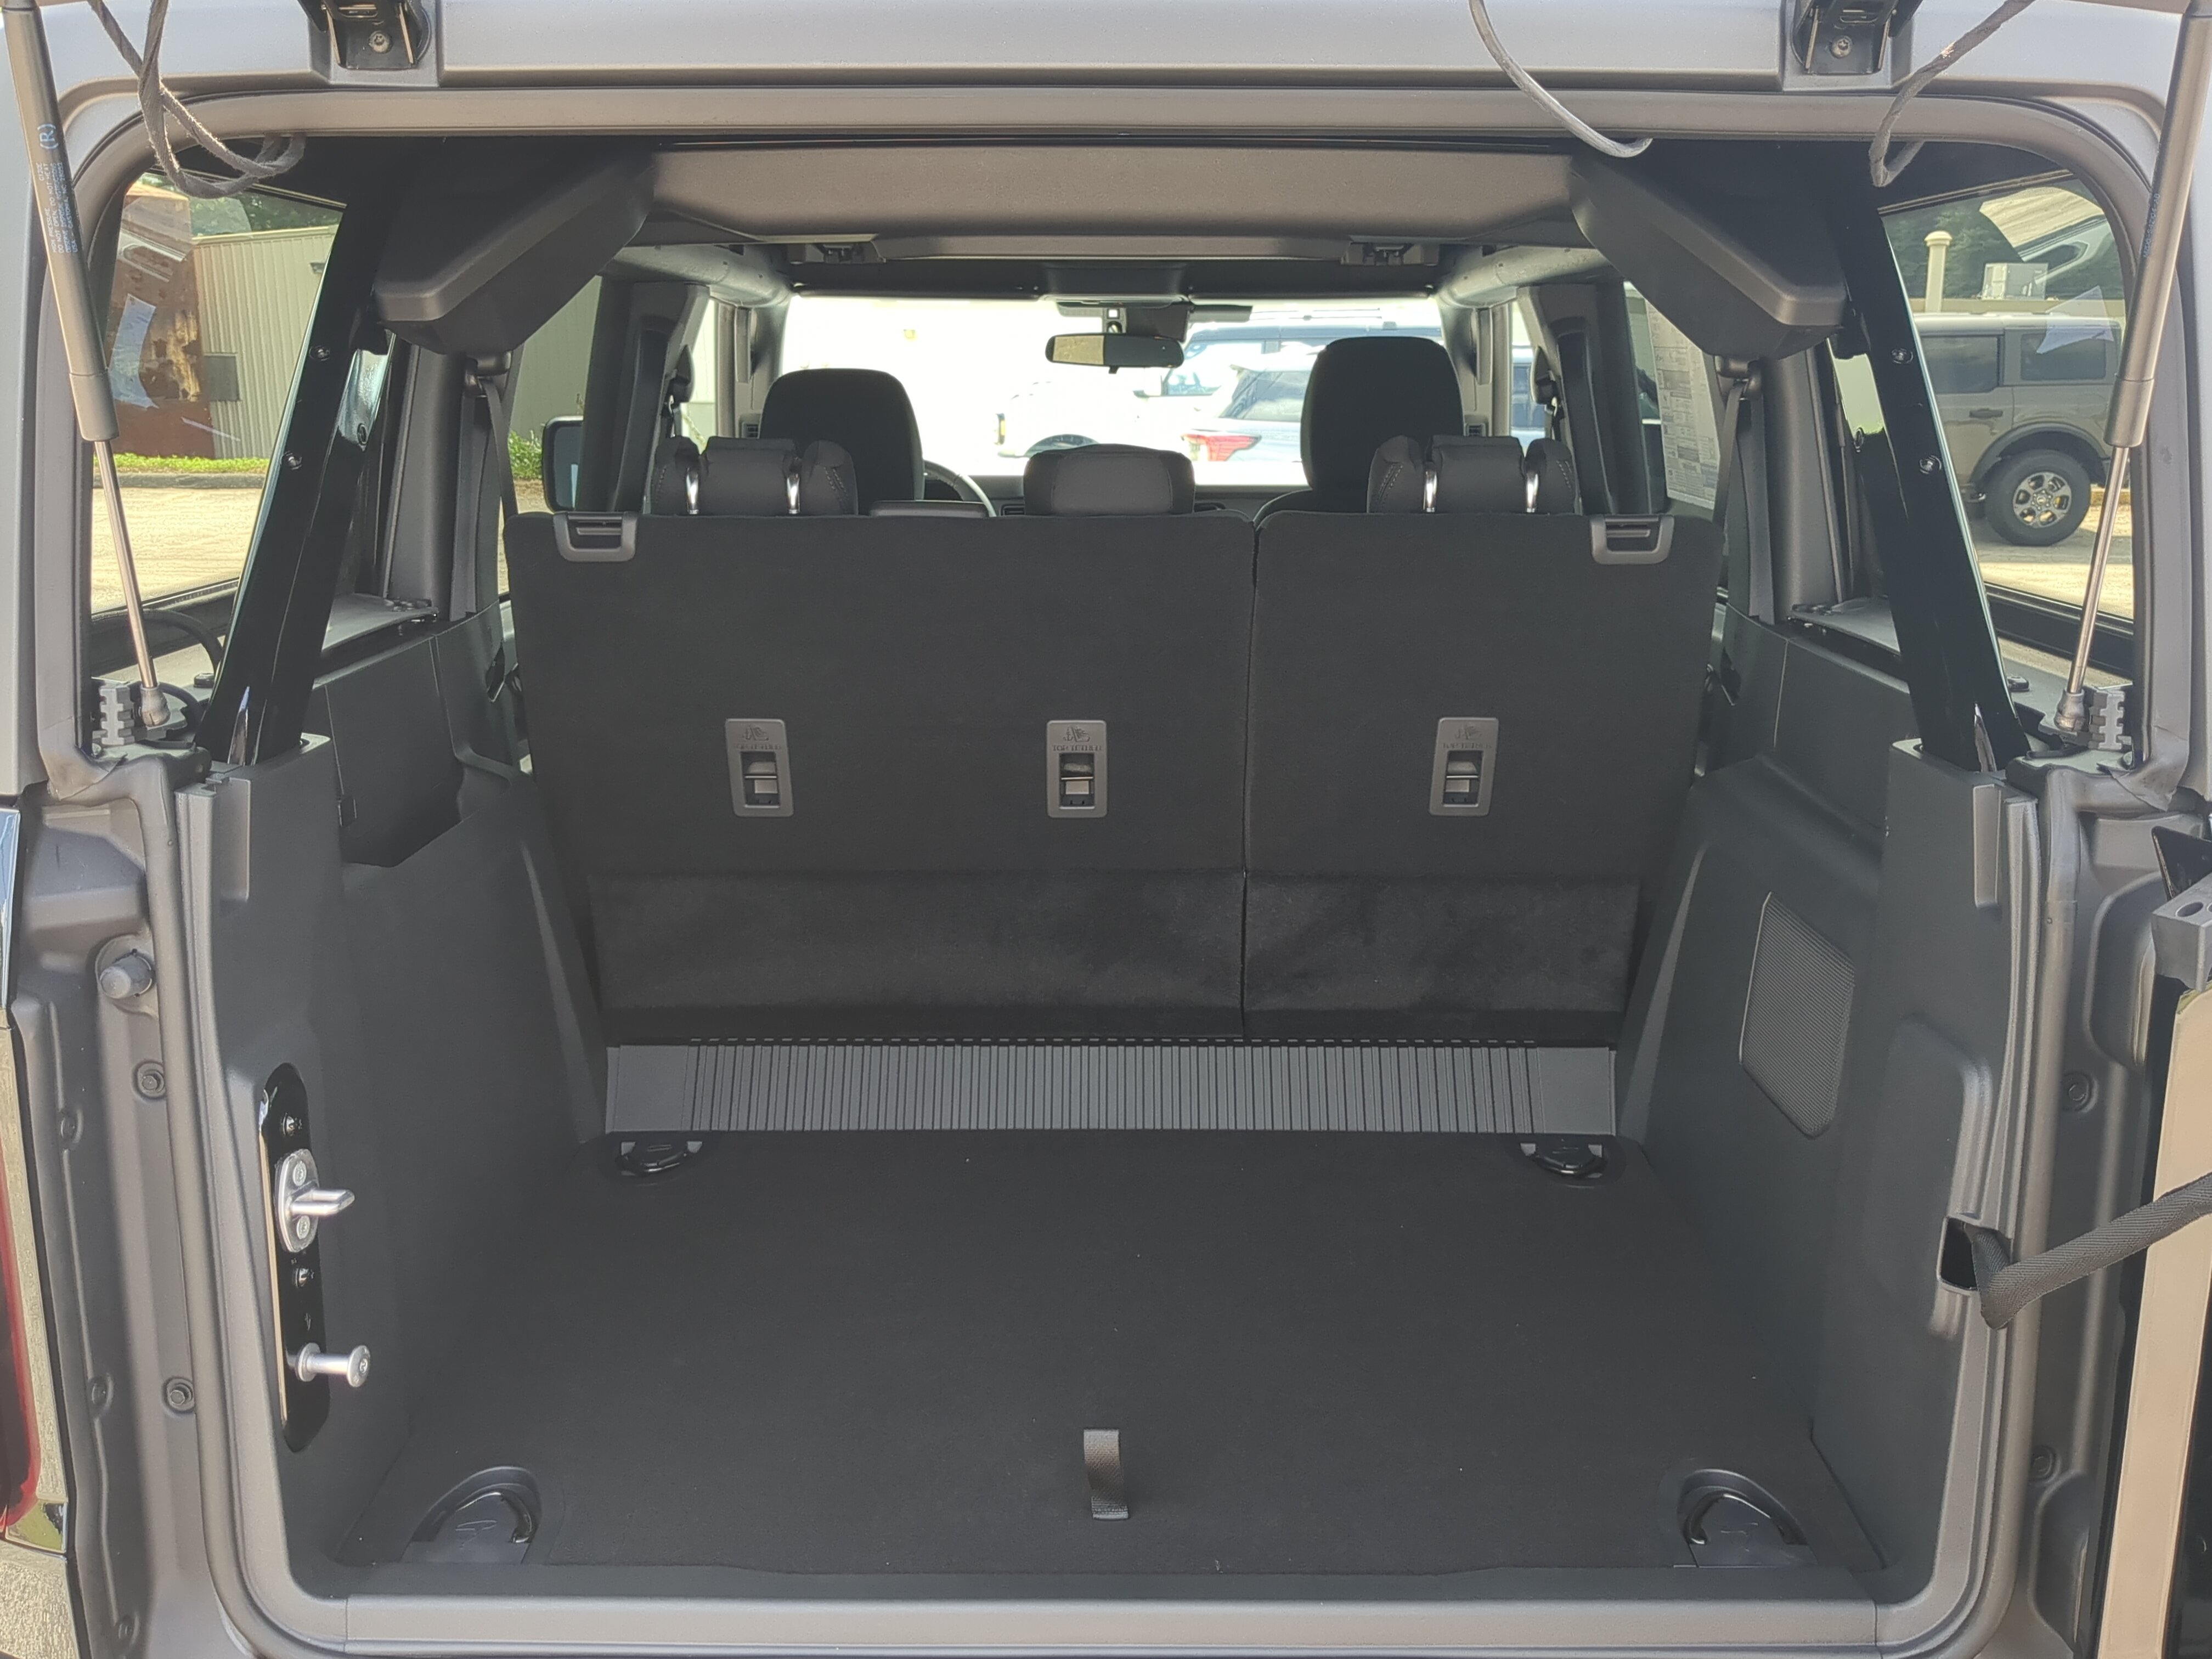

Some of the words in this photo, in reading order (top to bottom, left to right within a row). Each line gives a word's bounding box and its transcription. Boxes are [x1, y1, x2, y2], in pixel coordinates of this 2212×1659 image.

[37, 124, 59, 149] (R)
[61, 185, 67, 194] NC
[49, 198, 56, 206] DO
[44, 208, 54, 236] PRESSURE
[58, 245, 64, 253] DO
